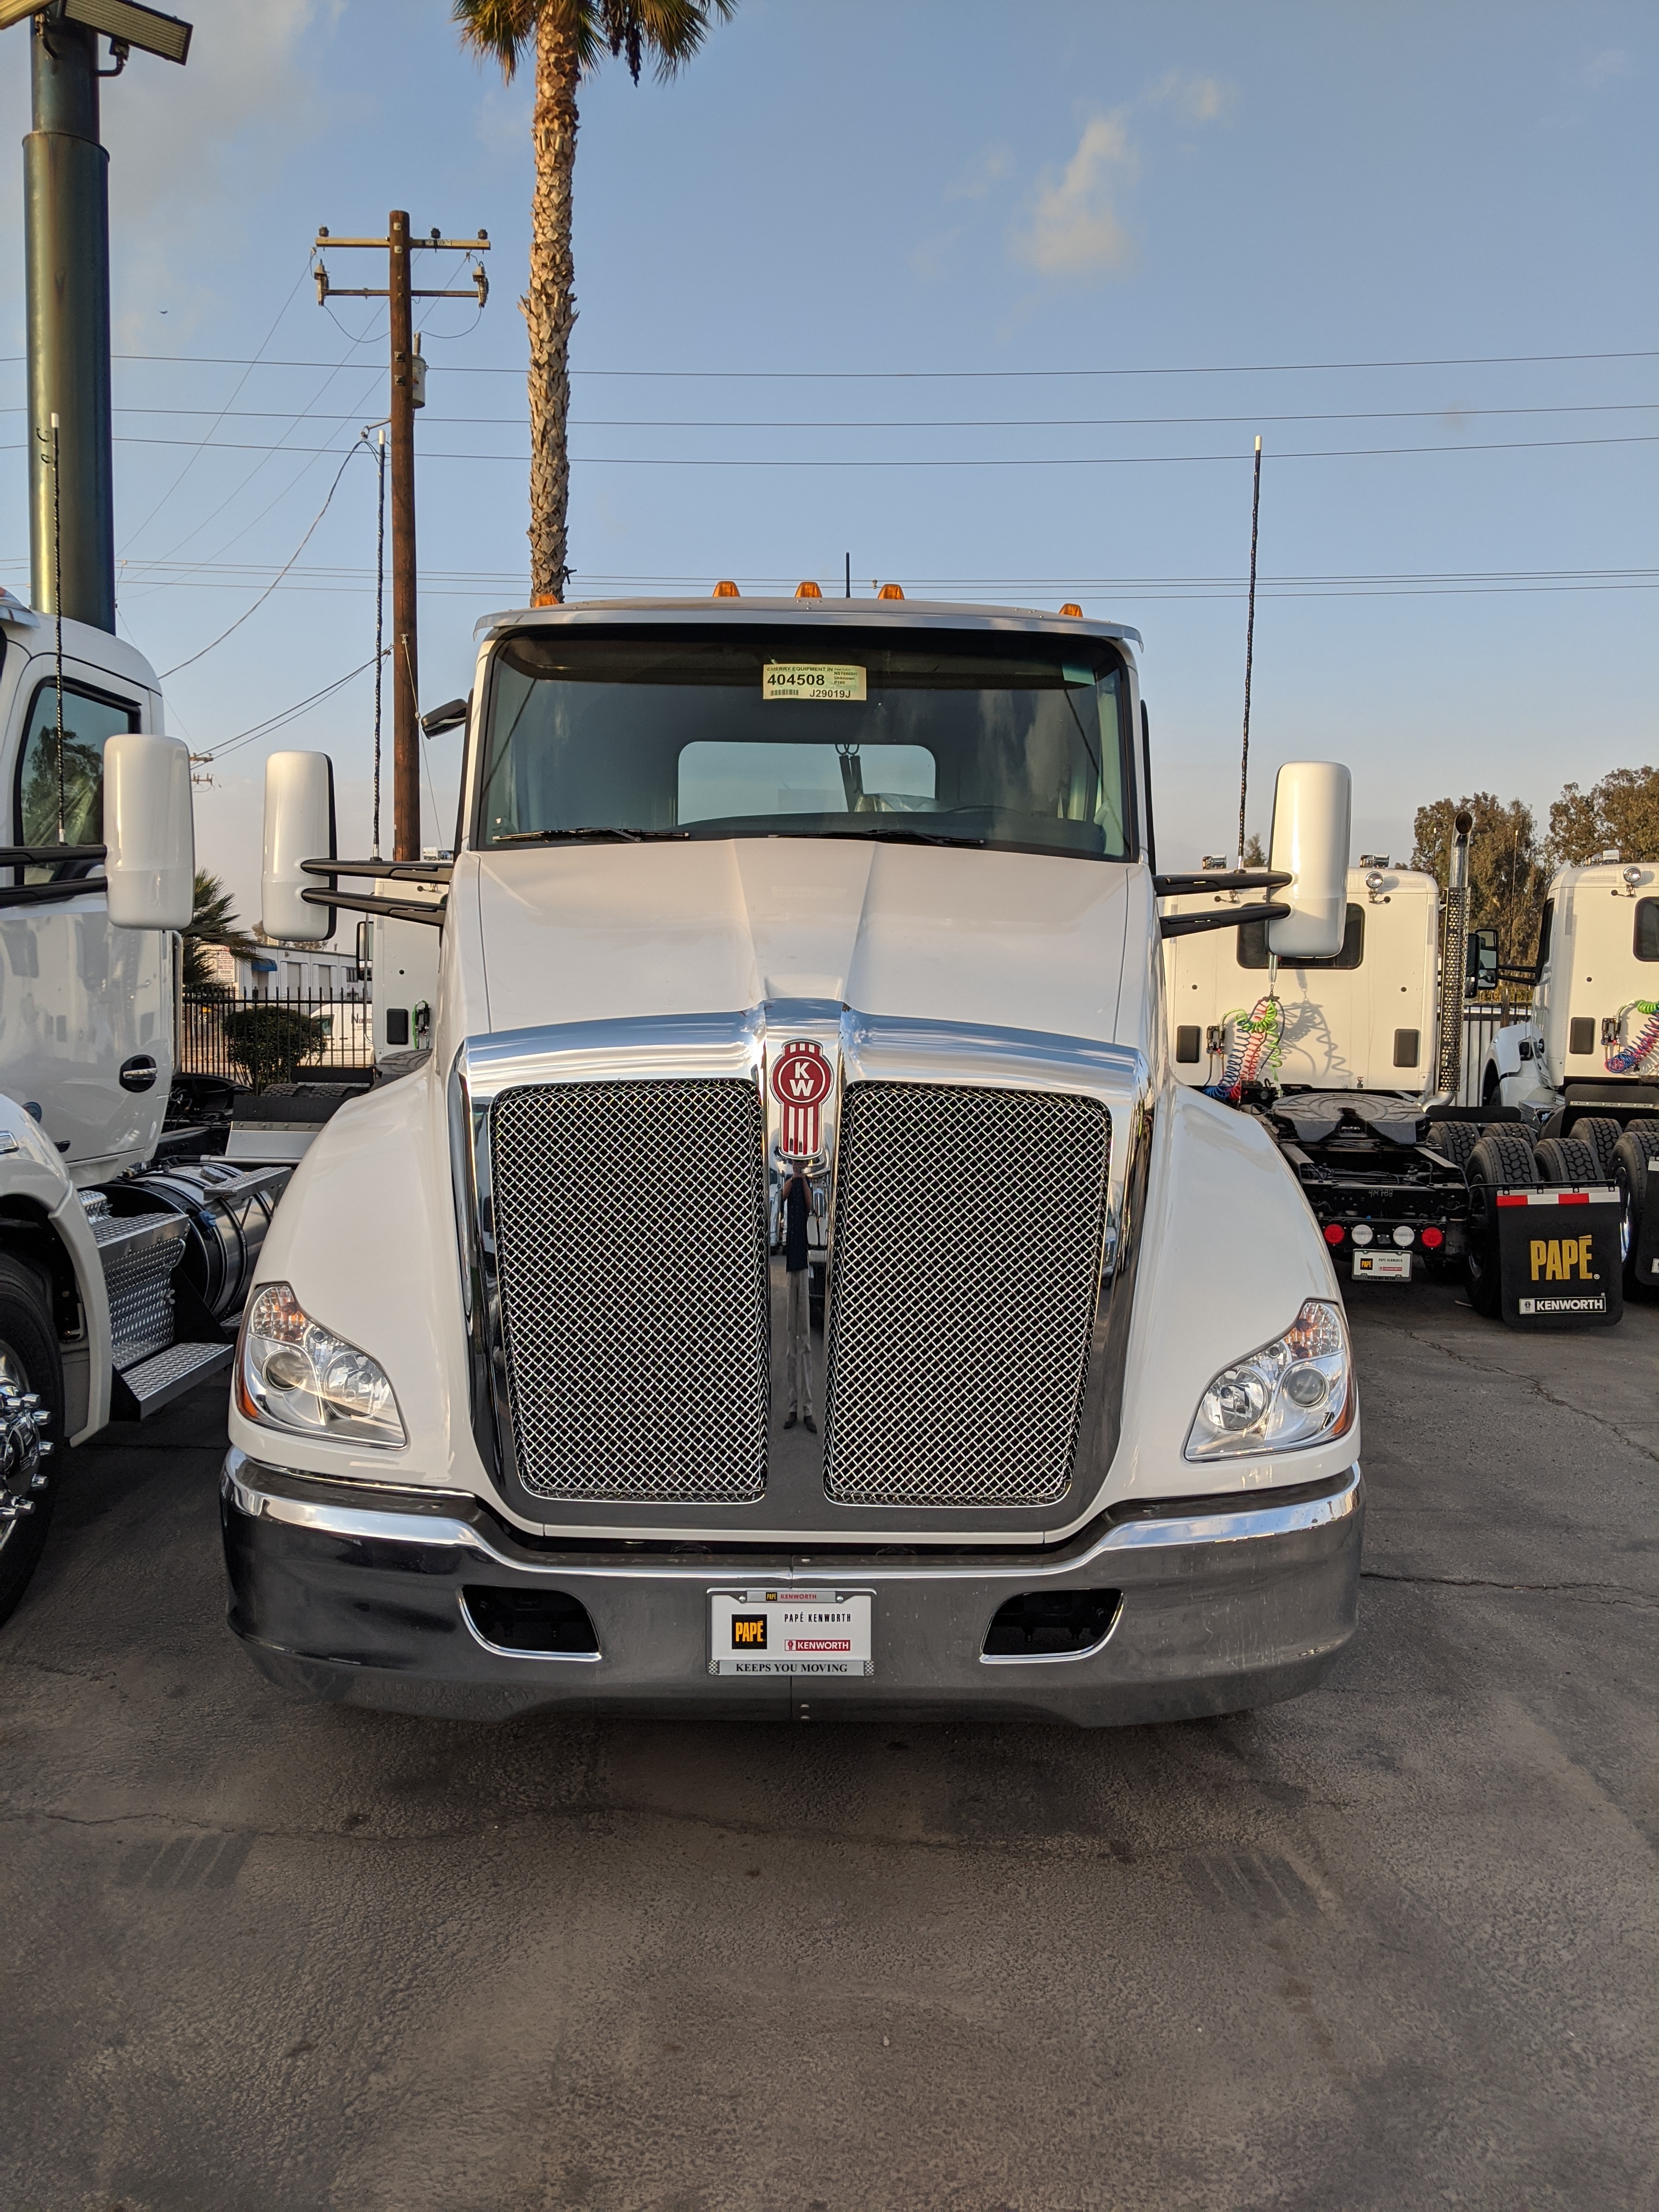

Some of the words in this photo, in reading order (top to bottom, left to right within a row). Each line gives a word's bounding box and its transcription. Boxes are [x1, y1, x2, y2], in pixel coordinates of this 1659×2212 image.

[767, 674, 825, 685] 404508
[809, 690, 850, 698] J29019J
[795, 1062, 810, 1079] K
[789, 1079, 814, 1097] W
[1530, 1234, 1593, 1280] PAPÉ
[1537, 1299, 1603, 1311] KENWORTH
[785, 1612, 804, 1622] PAPÉ
[808, 1613, 851, 1622] KENWORTH
[735, 1620, 764, 1642] PAPÉ
[797, 1641, 849, 1650] KENWORTH
[736, 1663, 771, 1672] KEEPS
[774, 1663, 797, 1672] YOU
[800, 1663, 848, 1673] MOVING
